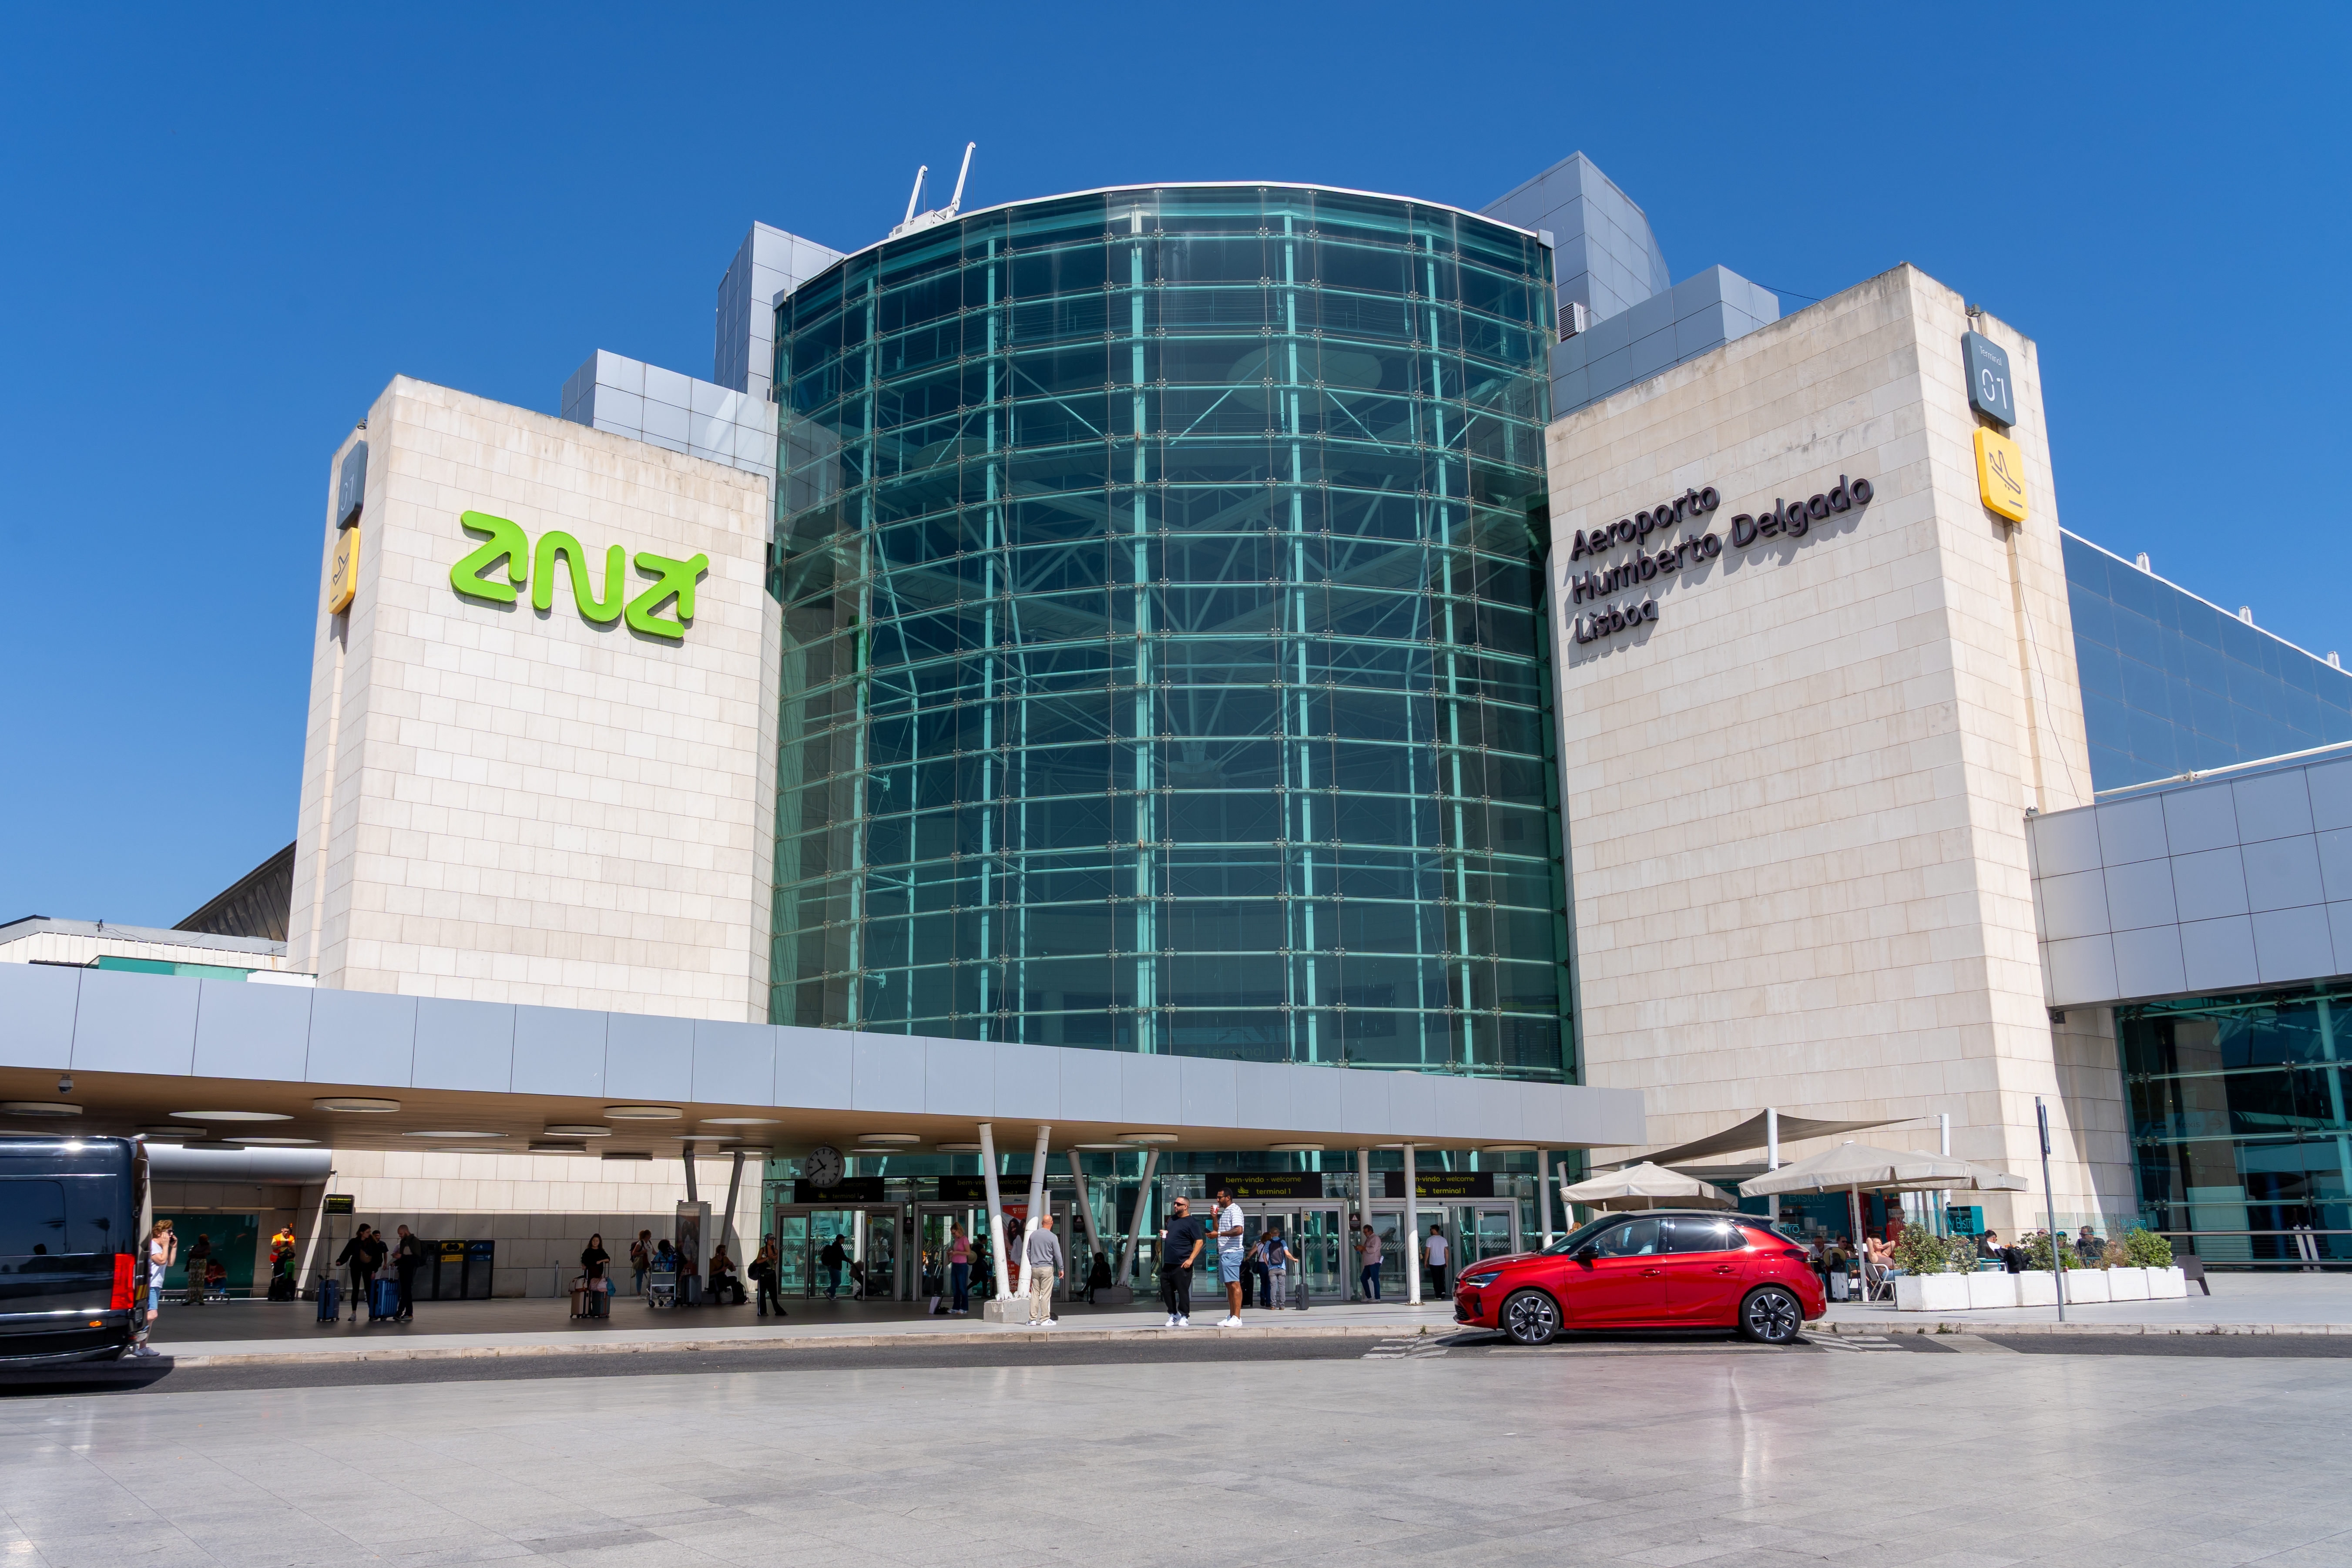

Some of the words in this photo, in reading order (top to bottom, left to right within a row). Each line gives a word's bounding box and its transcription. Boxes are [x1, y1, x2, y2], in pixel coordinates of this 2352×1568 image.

[1979, 345, 2002, 366] Terminal
[1982, 369, 2007, 410] 01
[341, 473, 354, 511] 01
[1571, 487, 1720, 561] Aeroporto
[1572, 533, 1722, 604] Humberto
[1731, 474, 1874, 548] Delgado
[1575, 600, 1659, 644] Lisboa
[1206, 1045, 1265, 1058] terminal
[1789, 1193, 1825, 1202] Bistro
[1943, 1218, 1954, 1230] My
[1956, 1217, 1975, 1229] Bistro
[2121, 1219, 2130, 1231] My
[2131, 1219, 2147, 1229] Bistro
